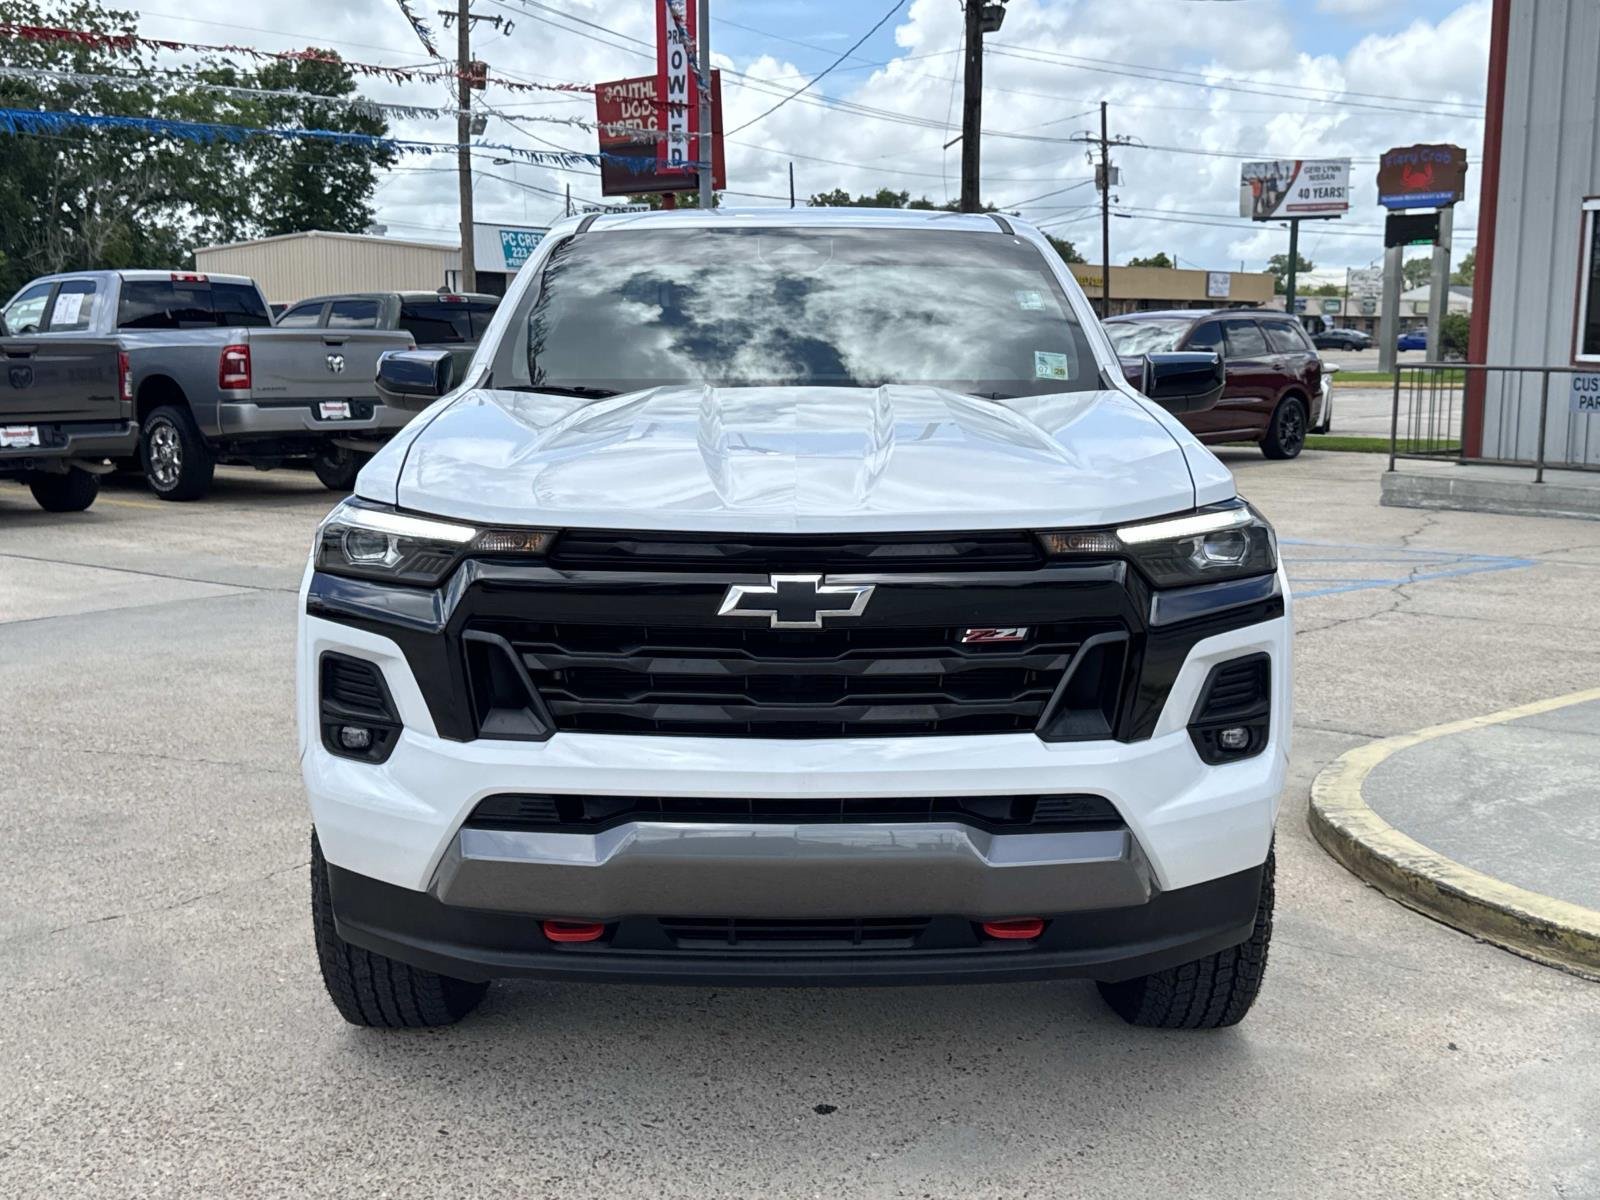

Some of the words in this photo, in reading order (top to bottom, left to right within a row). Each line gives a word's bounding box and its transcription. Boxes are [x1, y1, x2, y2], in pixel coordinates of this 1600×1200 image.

[1298, 188, 1310, 199] 40
[501, 231, 516, 246] PC
[962, 628, 1028, 643] Z71
